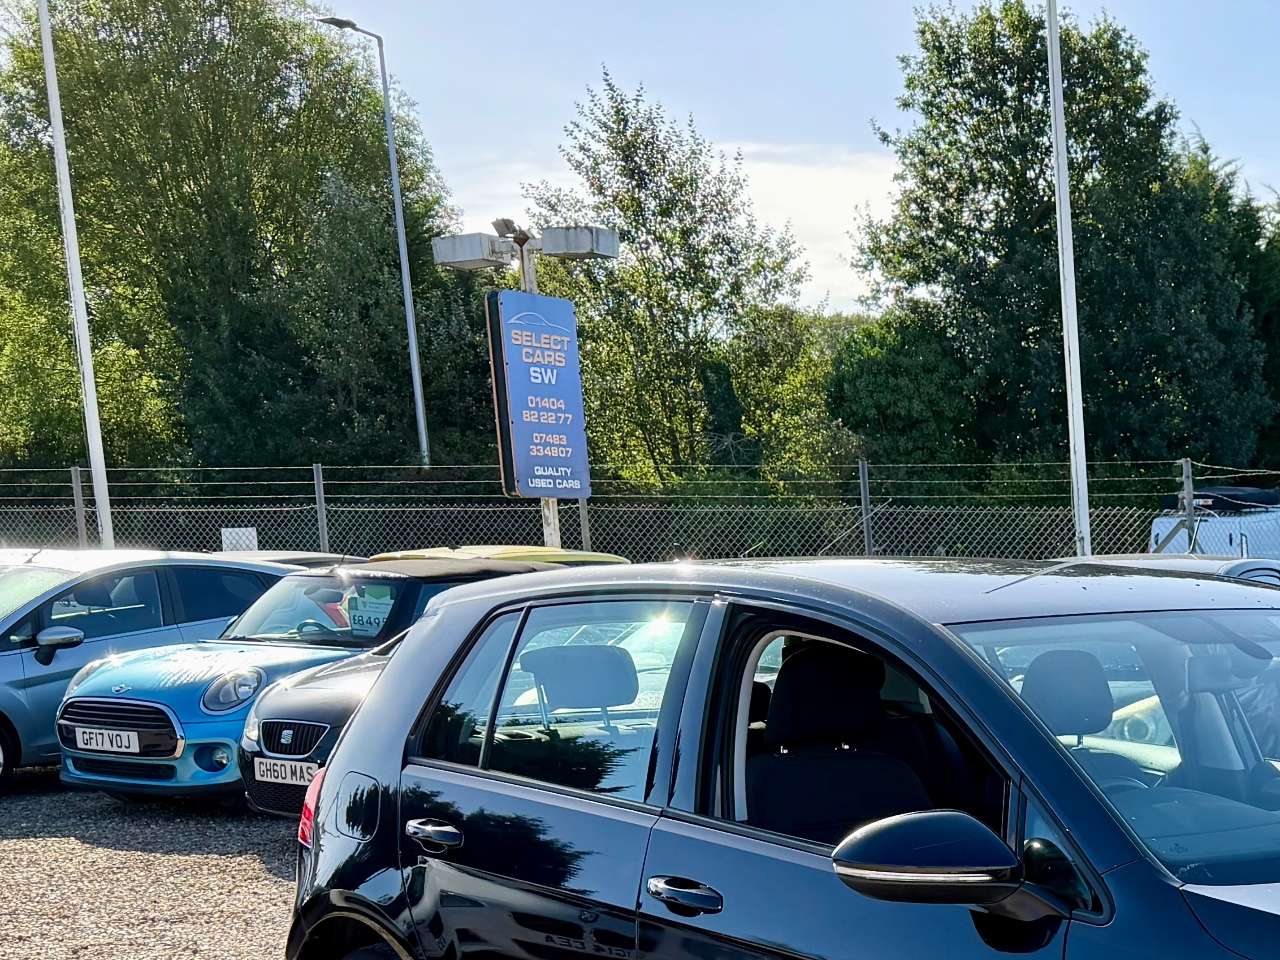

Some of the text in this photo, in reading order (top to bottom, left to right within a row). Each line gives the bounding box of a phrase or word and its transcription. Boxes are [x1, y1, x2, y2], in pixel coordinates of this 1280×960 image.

[511, 329, 570, 351] SELECT
[522, 348, 566, 367] CARS
[529, 366, 557, 385] SW
[527, 395, 565, 410] 01404
[534, 466, 572, 477] QUALITY
[528, 477, 581, 489] USED CARS
[82, 730, 131, 749] GF17 VOJ
[258, 761, 314, 782] GH60 MAS
